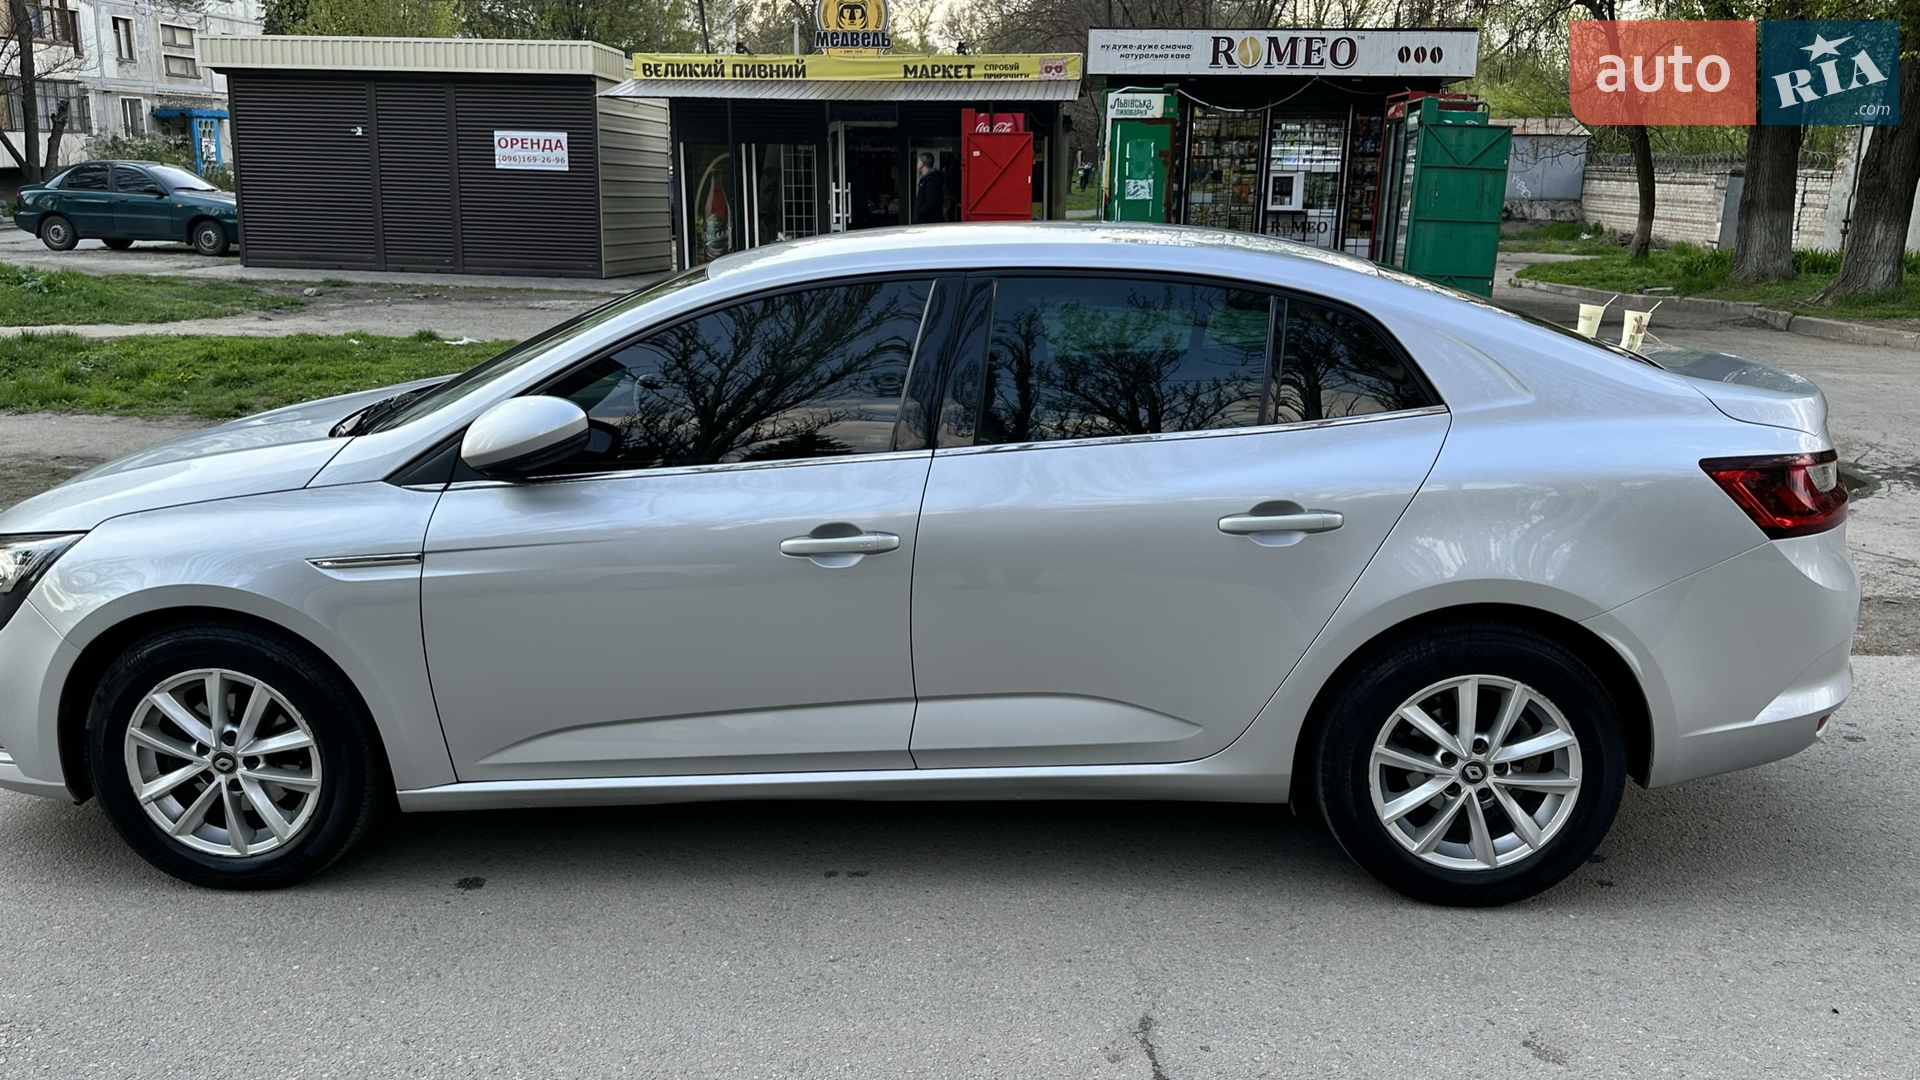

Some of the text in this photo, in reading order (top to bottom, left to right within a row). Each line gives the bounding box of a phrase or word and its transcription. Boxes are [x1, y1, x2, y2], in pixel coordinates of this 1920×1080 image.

[642, 59, 976, 79] ВЕЛИКИЙ ПИВНИЙ МАРКЕТ
[984, 62, 1020, 71] СПРОБУЙ
[497, 137, 565, 153] ОРЕНДА
[498, 155, 566, 164] (096)169-26-96
